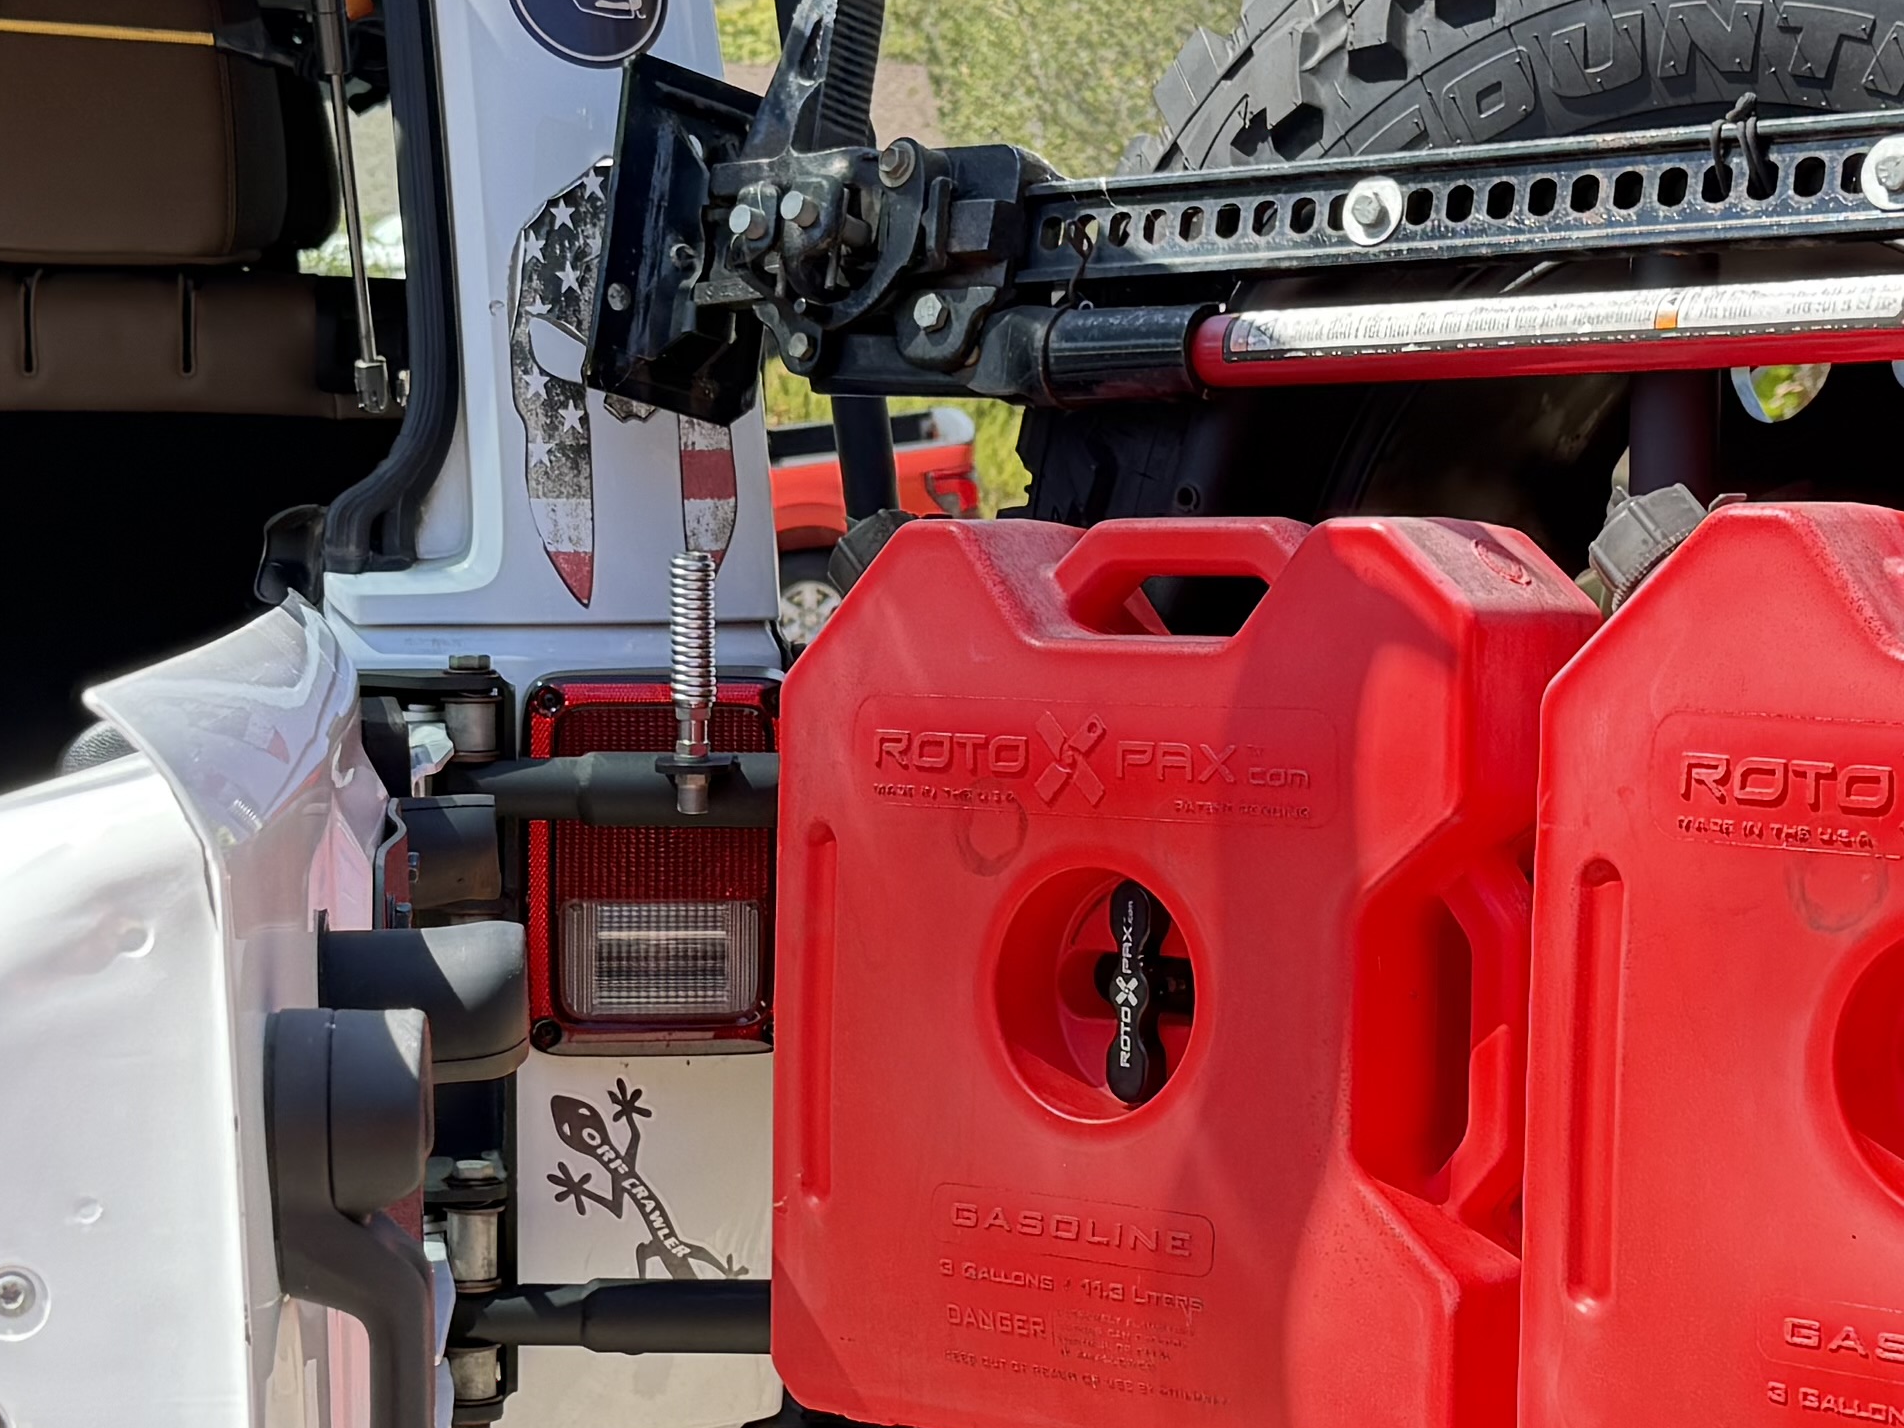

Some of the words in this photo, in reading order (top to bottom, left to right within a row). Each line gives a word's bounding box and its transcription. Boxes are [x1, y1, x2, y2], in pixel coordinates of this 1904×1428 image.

[874, 729, 1029, 778] ROTO
[1681, 751, 1895, 818] ROTO
[1742, 821, 1764, 840] IN
[1120, 1006, 1132, 1068] ROTO
[622, 1178, 691, 1258] CRAWLER
[951, 1202, 1193, 1257] GASOLINE
[939, 1258, 954, 1276] 3
[961, 1261, 1054, 1291] GALLONS
[1080, 1278, 1125, 1302] 11.3
[1132, 1283, 1205, 1314] LITERS
[946, 1303, 1047, 1339] DANGER
[1768, 1381, 1788, 1406] 3
